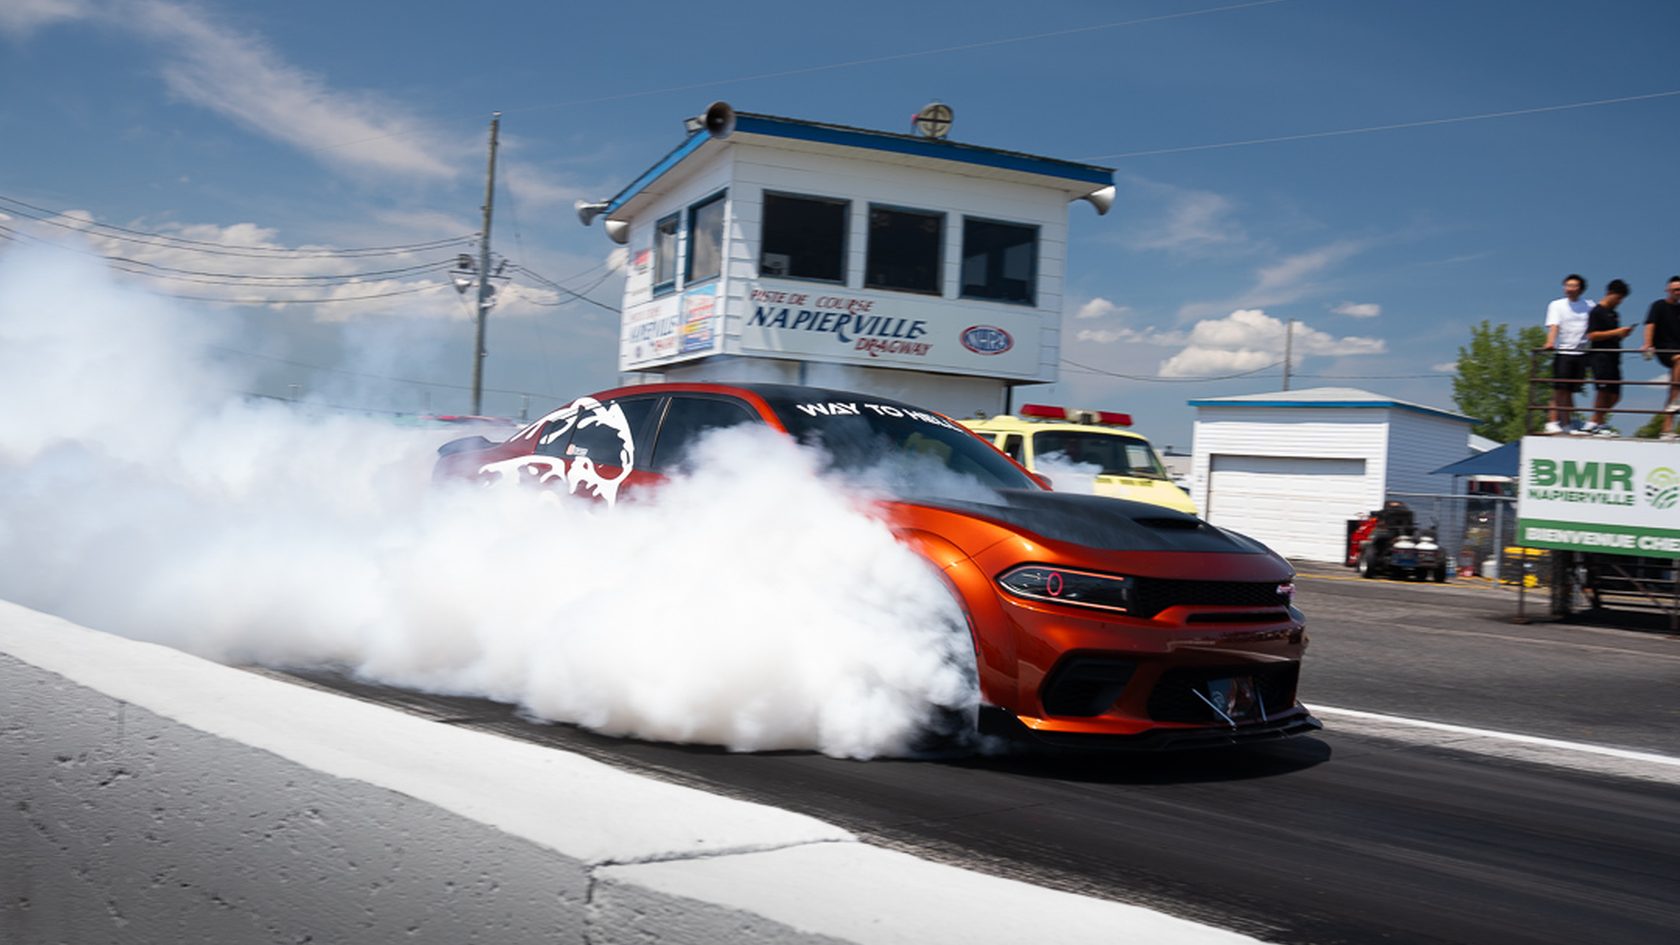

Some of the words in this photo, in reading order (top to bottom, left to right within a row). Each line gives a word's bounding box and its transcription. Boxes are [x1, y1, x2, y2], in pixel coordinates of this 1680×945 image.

[787, 292, 808, 306] DE
[815, 296, 875, 315] COURSE
[747, 306, 928, 343] NAPIERVILLE
[854, 337, 934, 358] DRAGWAY
[796, 402, 861, 417] WAY
[864, 403, 904, 418] TO
[1529, 458, 1634, 491] BMR
[1528, 488, 1636, 507] NAPIERVILLE
[1525, 527, 1637, 549] BIENVENUE
